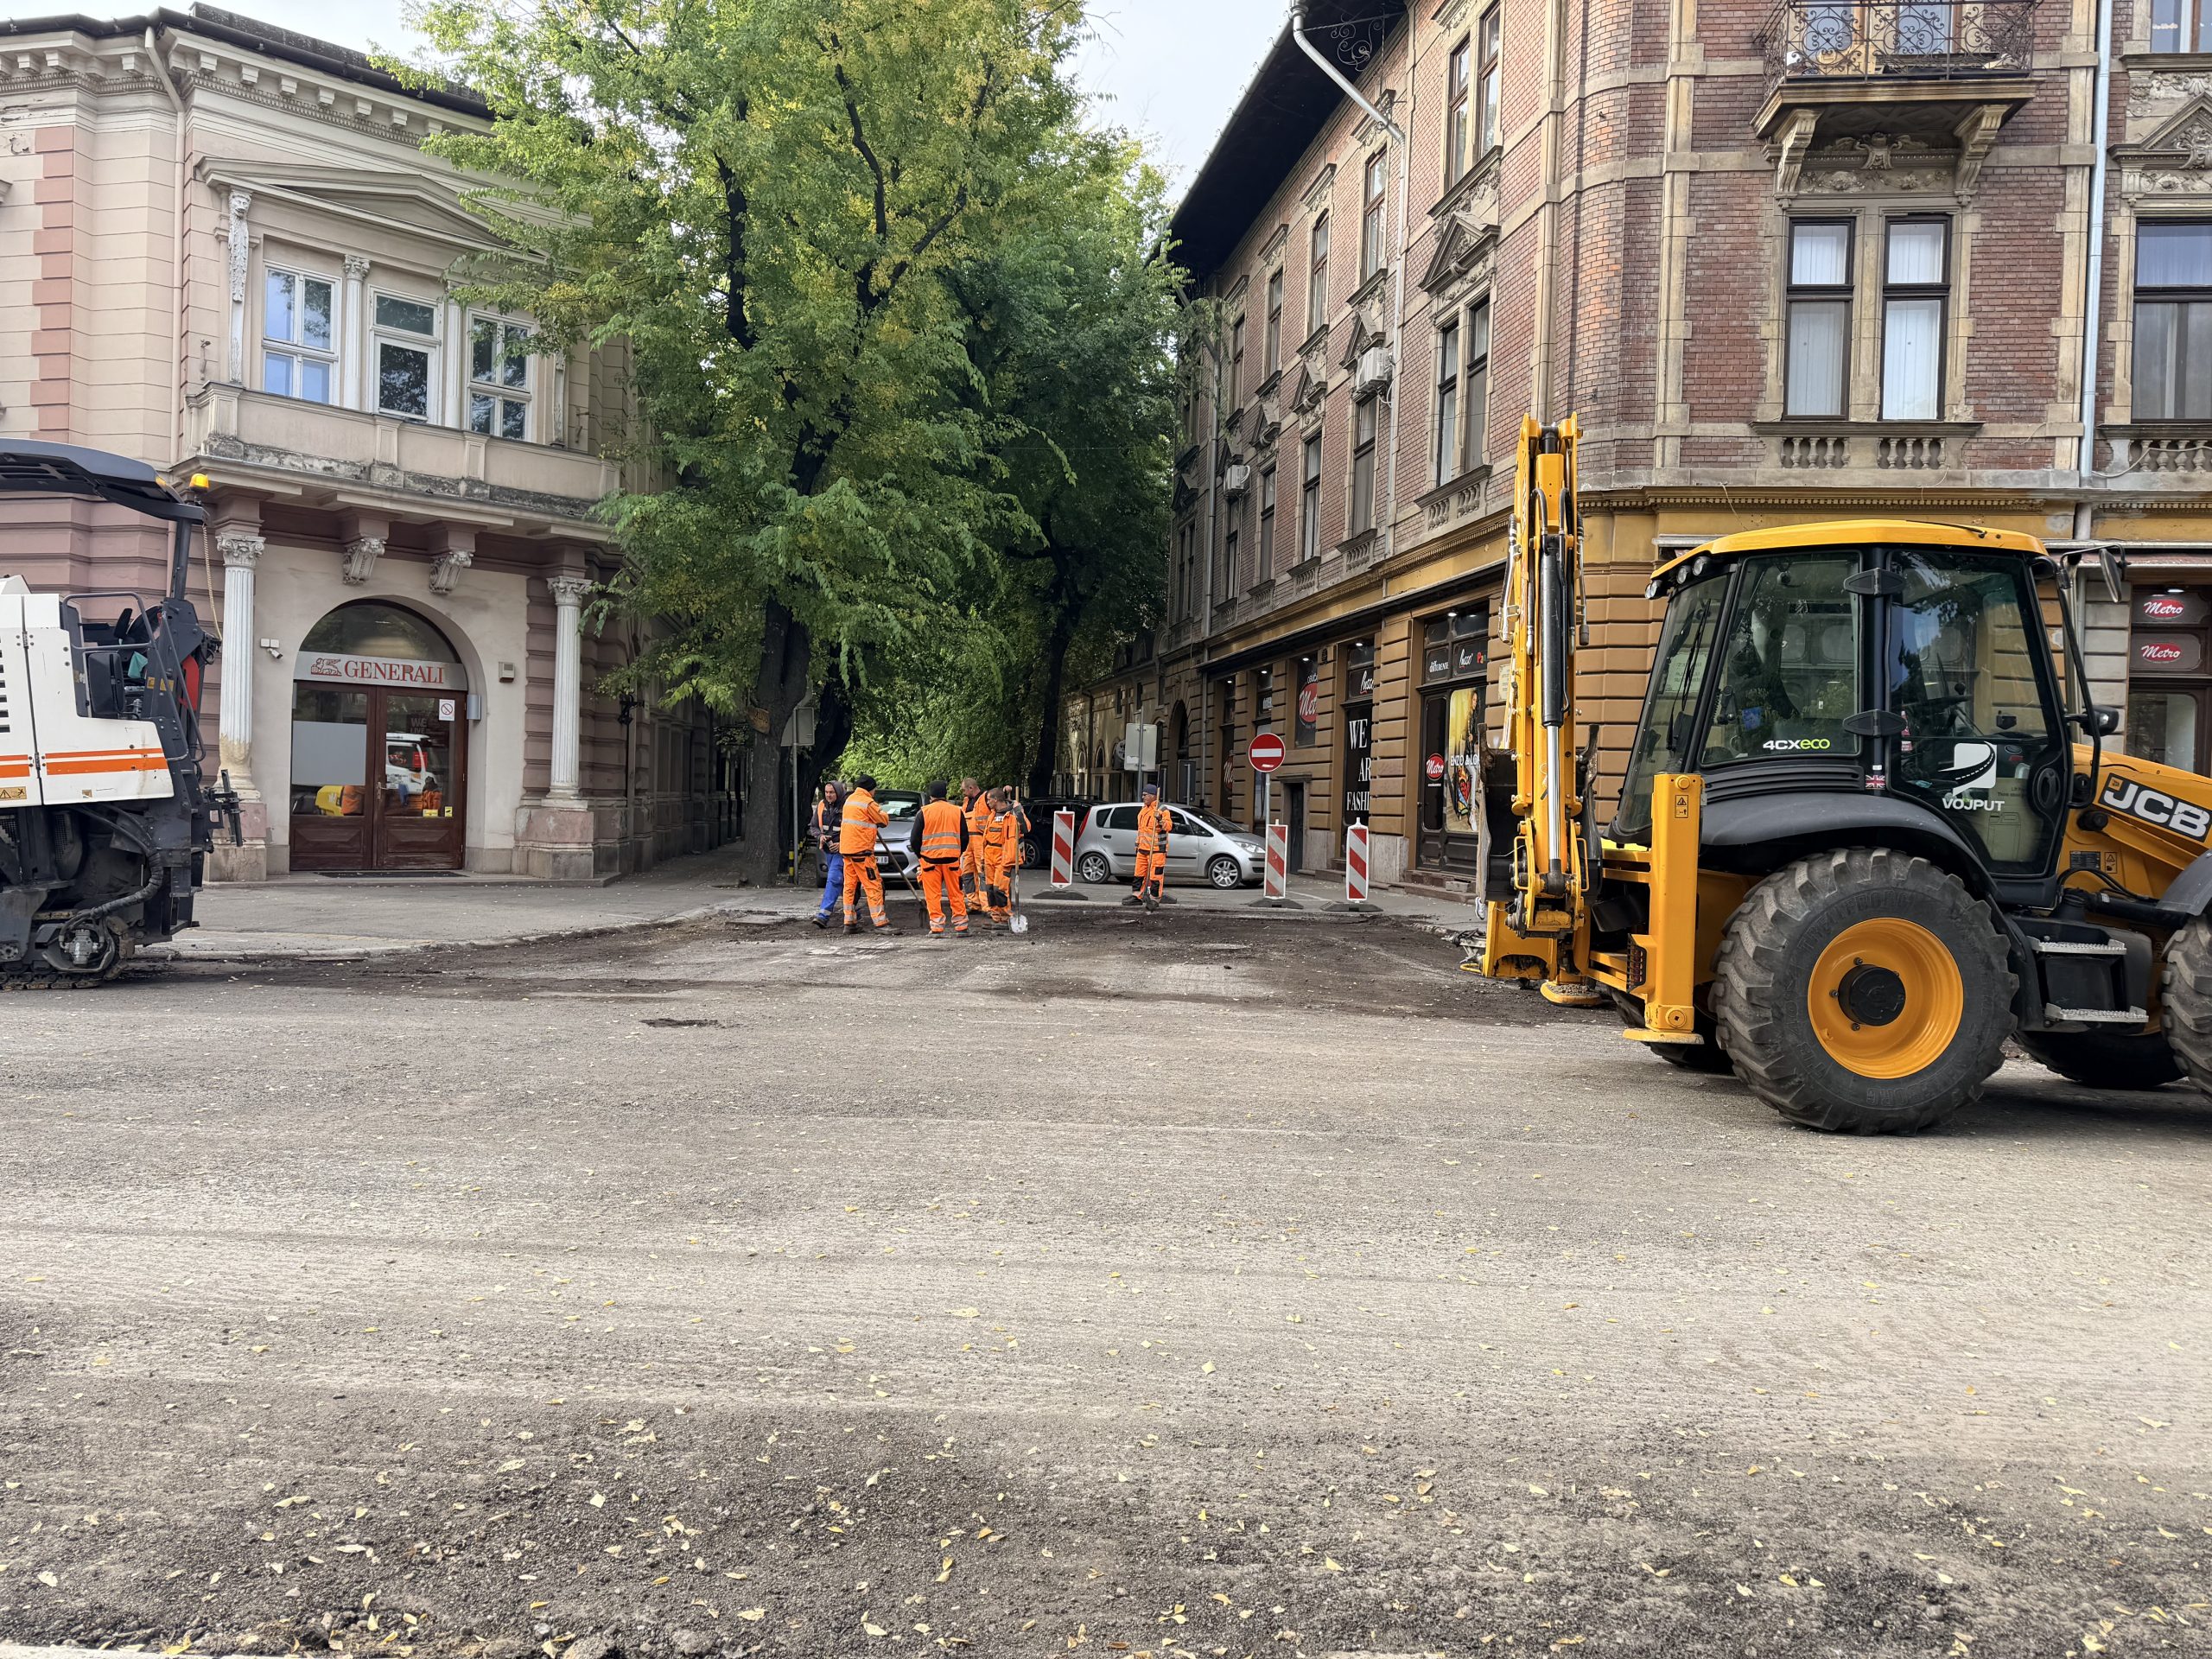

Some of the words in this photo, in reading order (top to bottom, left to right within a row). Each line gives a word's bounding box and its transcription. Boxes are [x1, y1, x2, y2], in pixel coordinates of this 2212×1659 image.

[2144, 601, 2183, 614] Metro
[2141, 645, 2181, 658] Metro
[345, 660, 444, 684] GENERALI
[1349, 718, 1368, 750] WE
[1427, 759, 1444, 775] Metro
[1451, 754, 1465, 766] ENZO
[1358, 757, 1371, 782] AR
[1942, 798, 2005, 811] VOJPUT
[2103, 783, 2210, 837] JCB
